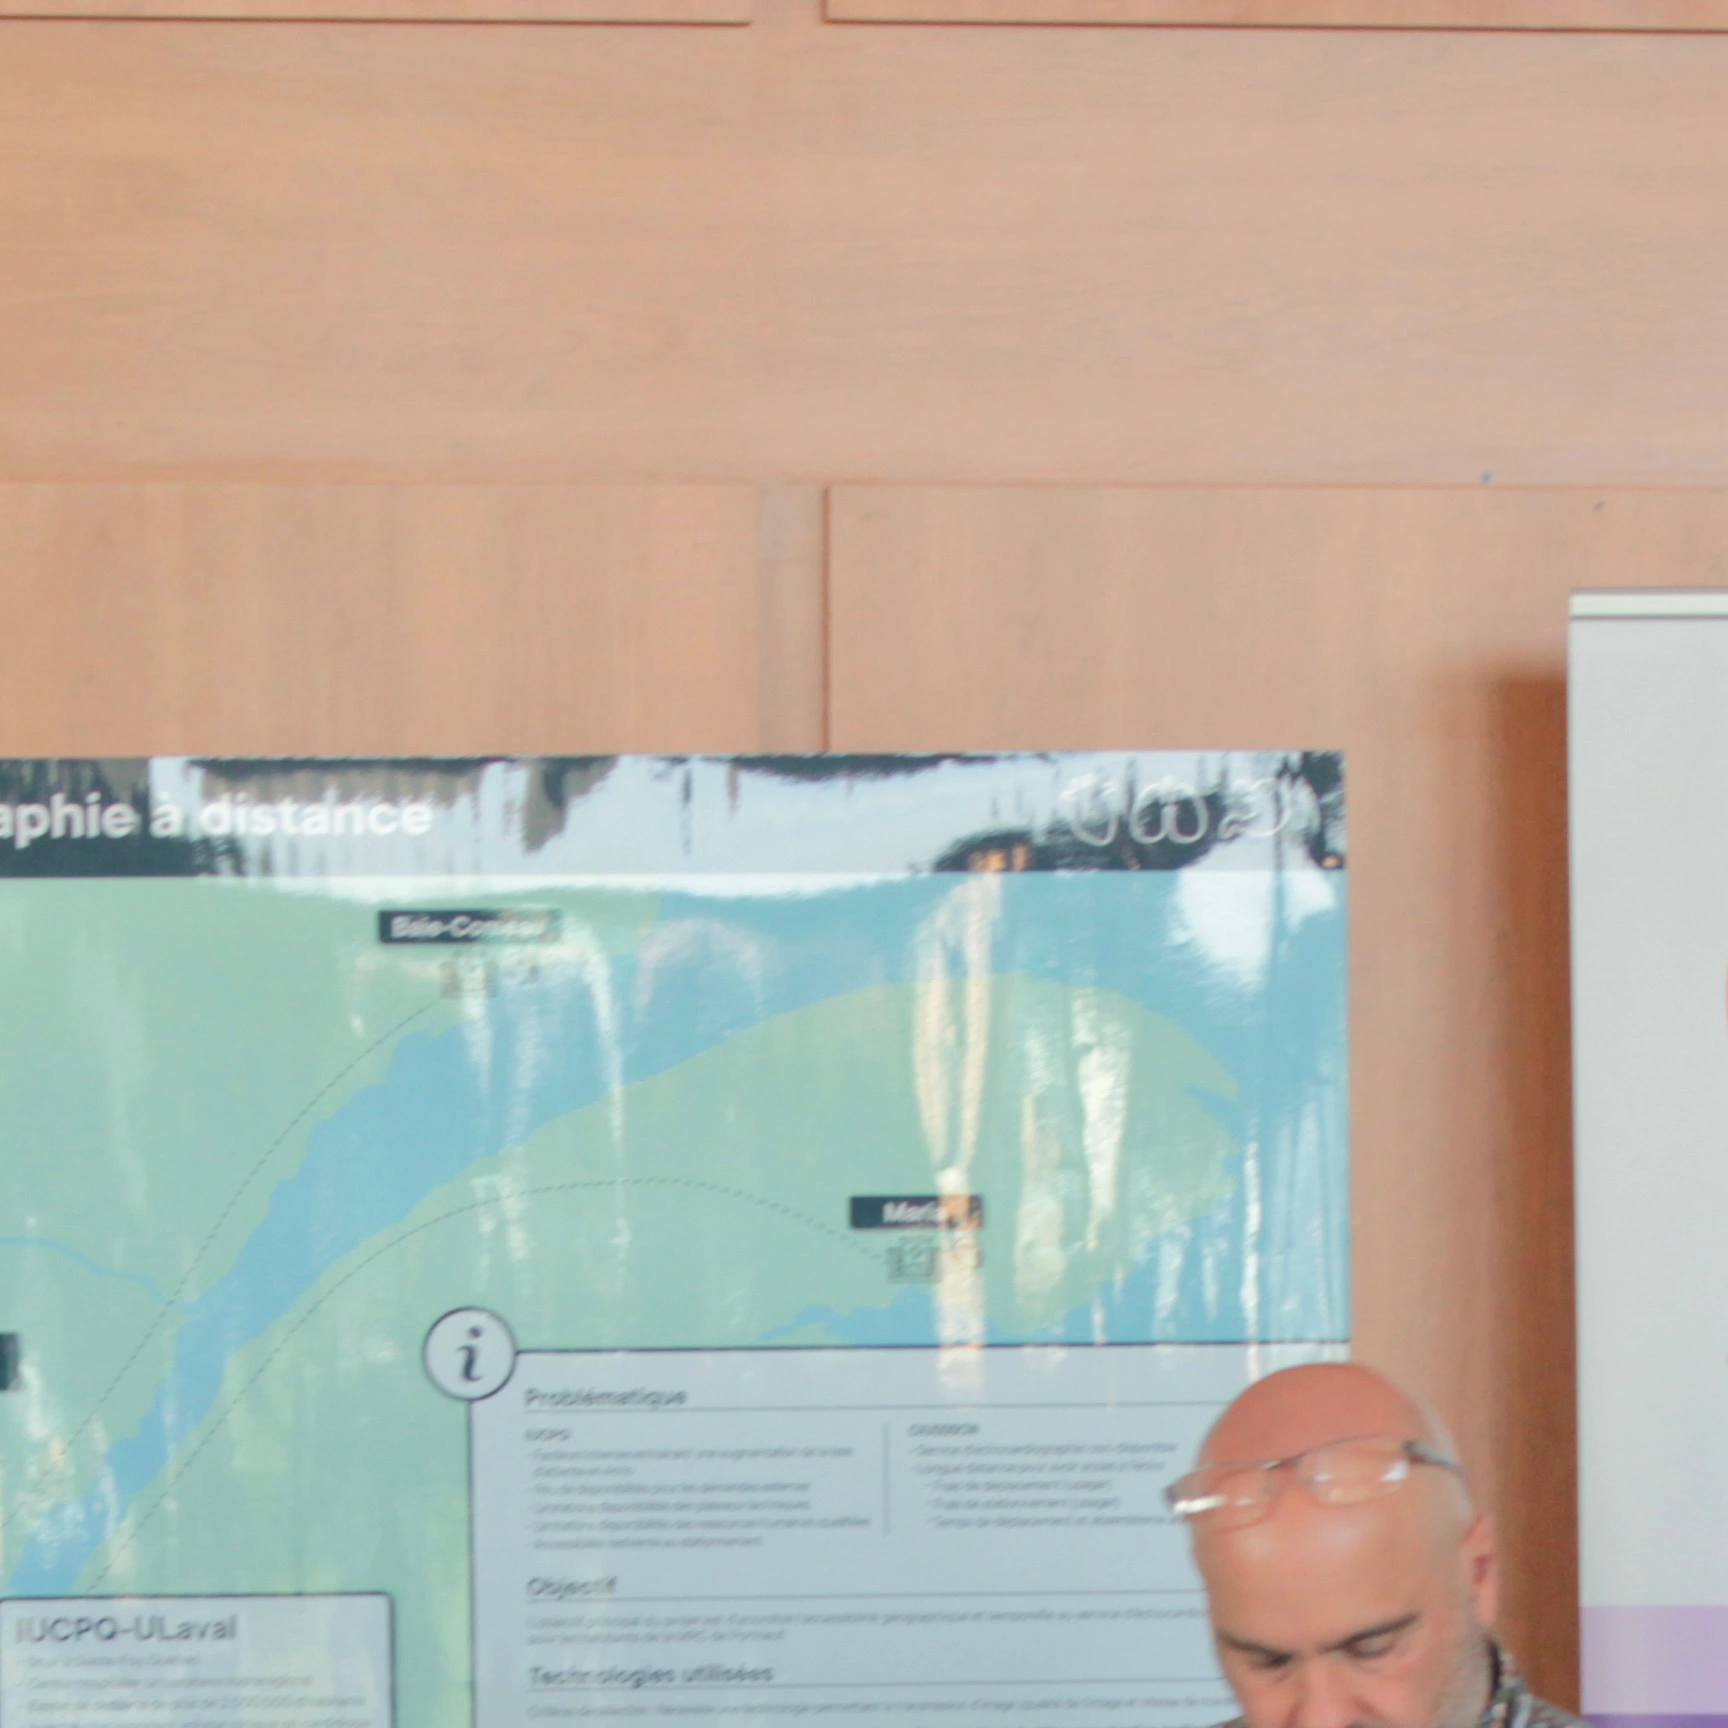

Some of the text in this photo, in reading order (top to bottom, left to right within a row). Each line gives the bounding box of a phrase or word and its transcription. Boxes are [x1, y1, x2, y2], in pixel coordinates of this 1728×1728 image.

[150, 792, 178, 837] à
[197, 790, 434, 837] distance
[524, 1385, 687, 1408] Problématique
[526, 1576, 617, 1598] Objectif
[16, 1614, 238, 1645] IUCPQ-ULaval
[529, 1663, 775, 1688] Technologies utilisées
